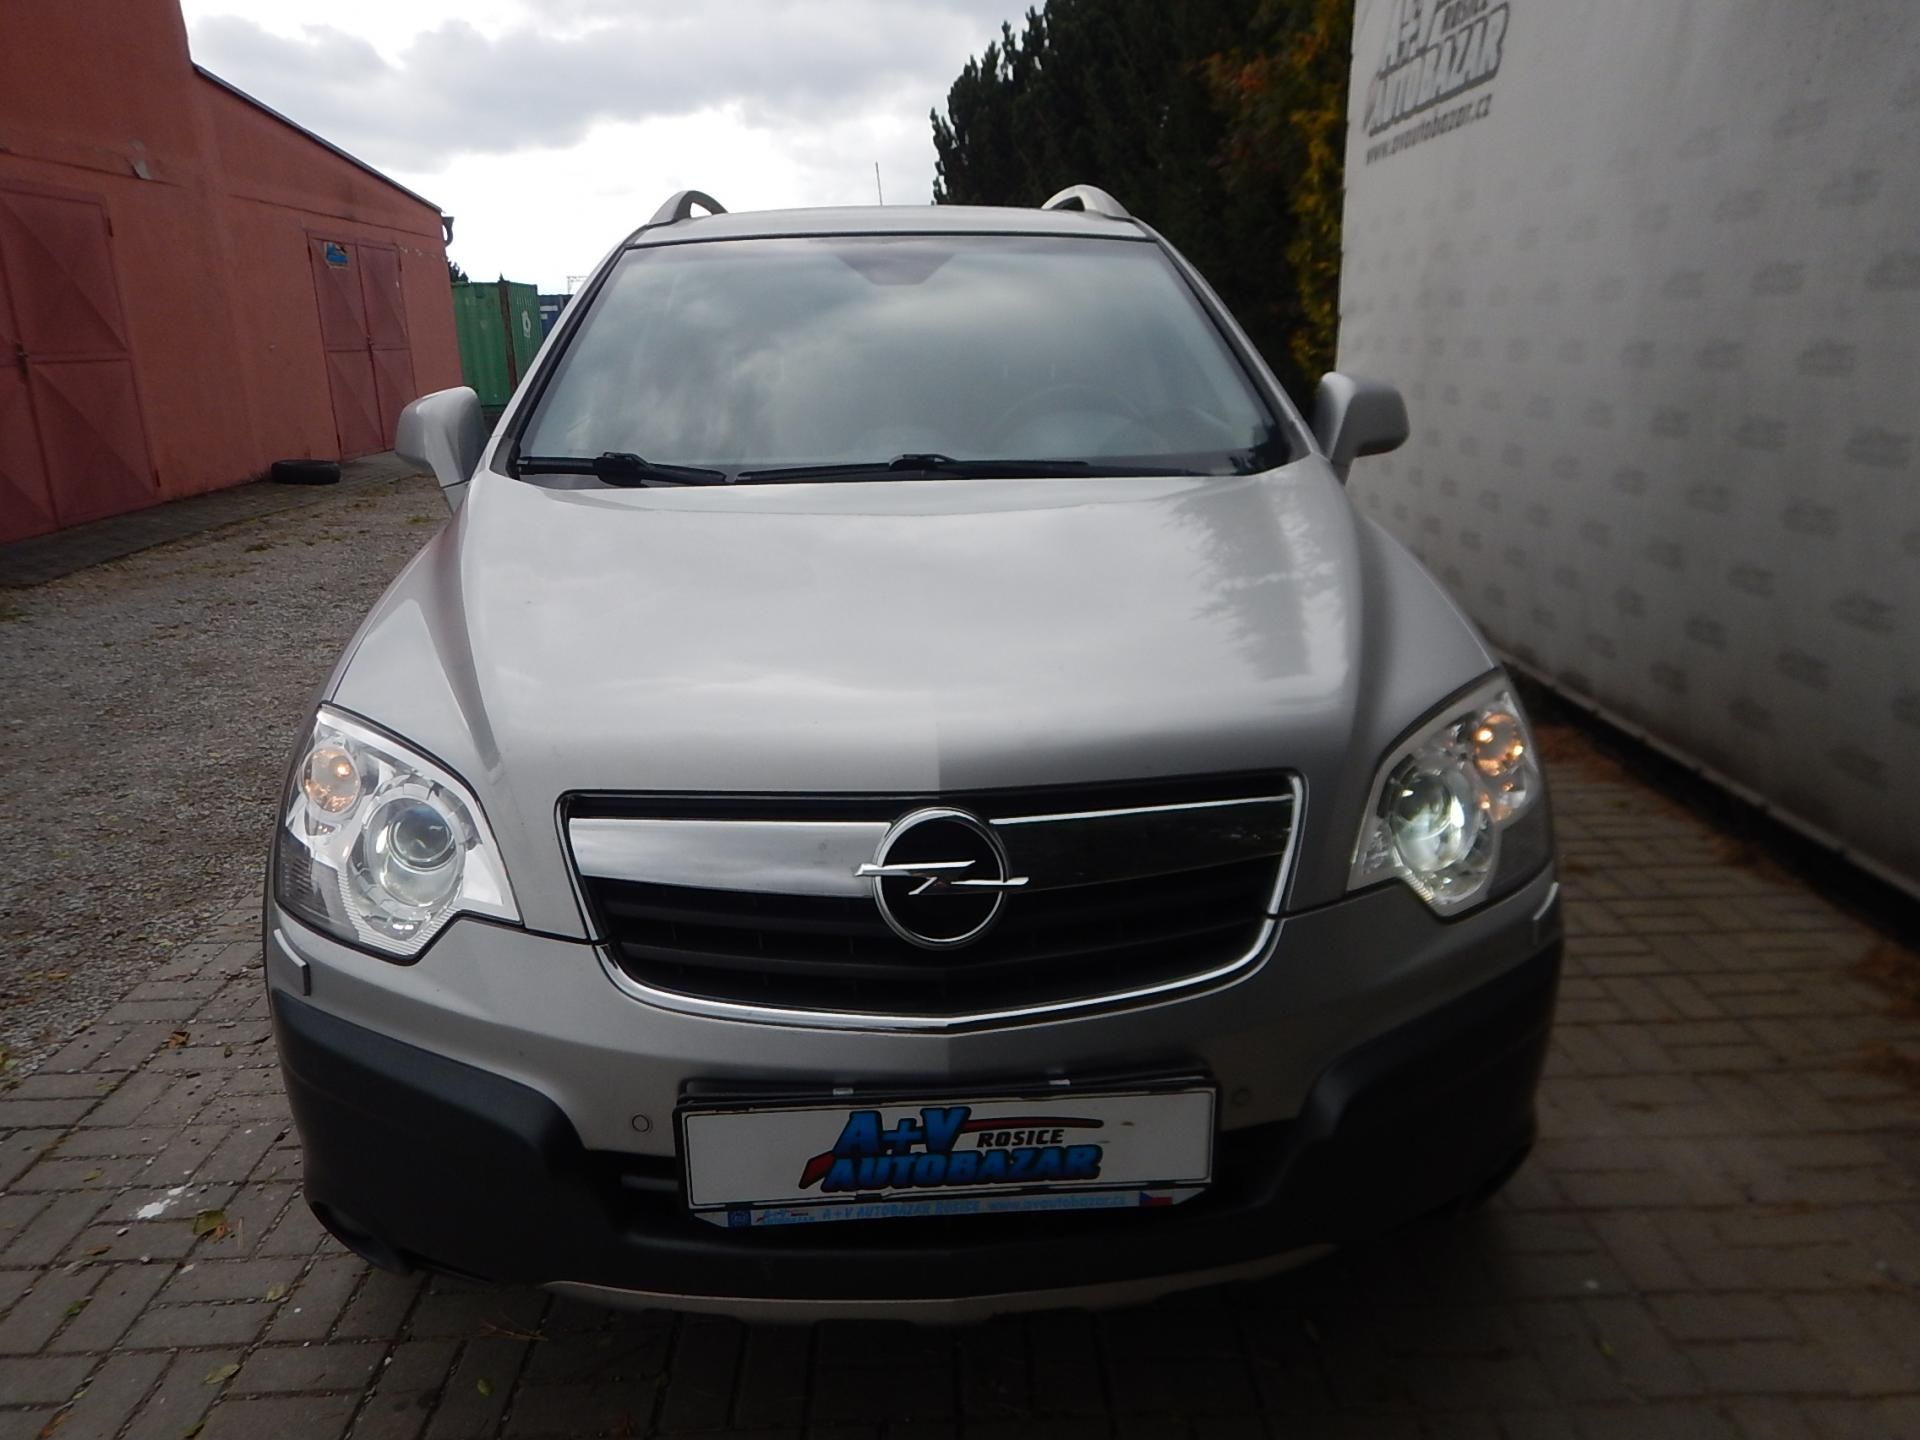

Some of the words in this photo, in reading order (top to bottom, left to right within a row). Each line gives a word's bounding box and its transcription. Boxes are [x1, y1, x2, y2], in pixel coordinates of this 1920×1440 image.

[1368, 2, 1508, 138] AUTOBAZAR
[831, 1106, 972, 1156] A+V
[976, 1128, 1065, 1148] ROSICE
[820, 1143, 1104, 1193] AUTOBAZAR
